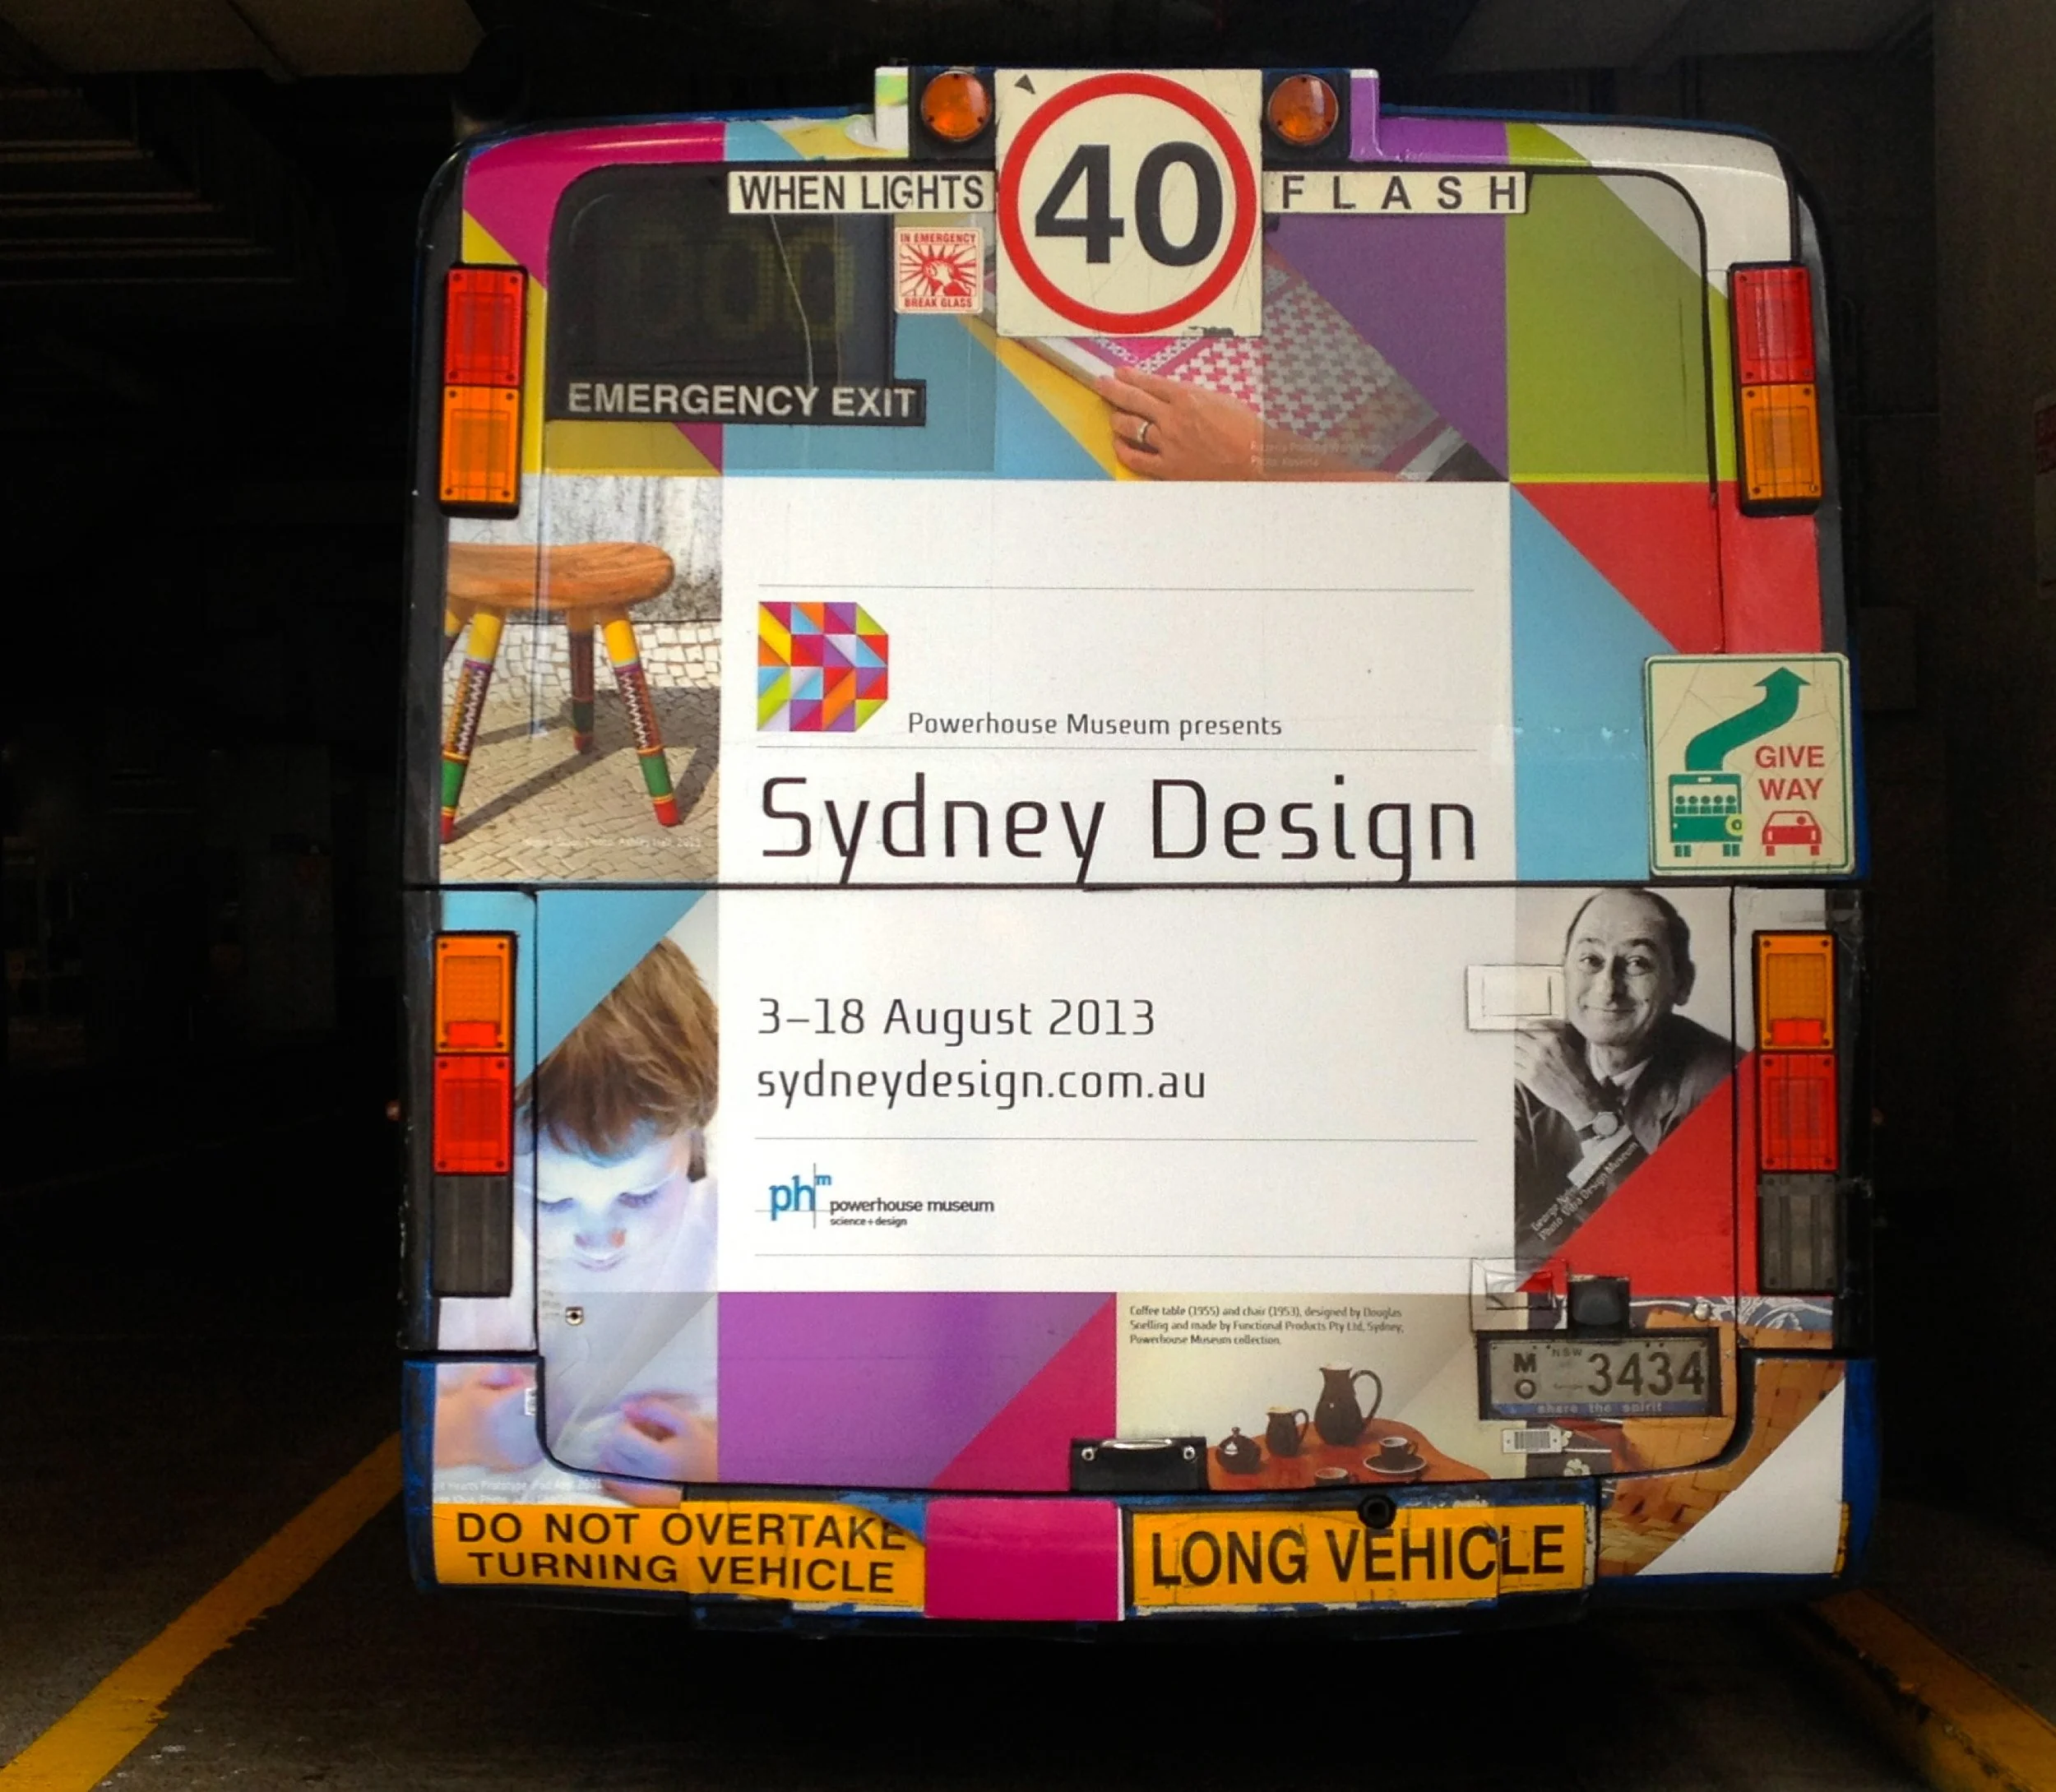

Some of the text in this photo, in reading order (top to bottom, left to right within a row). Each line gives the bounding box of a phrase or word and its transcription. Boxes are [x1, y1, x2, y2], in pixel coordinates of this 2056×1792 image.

[739, 174, 985, 211] WHEN LIGHTS
[1035, 141, 1224, 267] 40
[900, 233, 976, 243] IN EMERGENCY
[904, 297, 973, 308] BREAK GLASS
[567, 382, 917, 418] EMERGENCY EXIT
[907, 711, 1283, 741] Powerhouse Museum presents
[1754, 744, 1826, 769] GIVE
[1757, 777, 1825, 801] WAY
[761, 771, 1477, 885] Sydney Design
[882, 998, 1033, 1047] August
[1048, 998, 1156, 1036] 2013
[756, 1058, 1206, 1110] sydneydesign.com.au
[829, 1197, 995, 1216] powerhouse museum
[1129, 1305, 1160, 1316] Coffee
[1161, 1305, 1186, 1316] table
[1222, 1305, 1240, 1316] and
[1243, 1305, 1266, 1316] chair
[1304, 1306, 1347, 1320] designed
[1350, 1306, 1361, 1320] by
[1363, 1307, 1403, 1320] Douglas
[1171, 1319, 1189, 1331] and
[1191, 1319, 1217, 1331] made
[1220, 1319, 1231, 1332] by
[1233, 1319, 1283, 1331] Functional
[1285, 1320, 1327, 1331] Products
[1329, 1321, 1345, 1333] Pty
[1129, 1334, 1188, 1345] Powerhouse
[1190, 1334, 1232, 1345] Museum
[1587, 1350, 1705, 1396] 3434
[1588, 1402, 1612, 1414] the
[456, 1512, 907, 1551] DO NOT OVERTAKE
[466, 1551, 894, 1594] TURNING VEHICLE
[1152, 1524, 1566, 1588] LONG VEHICLE
